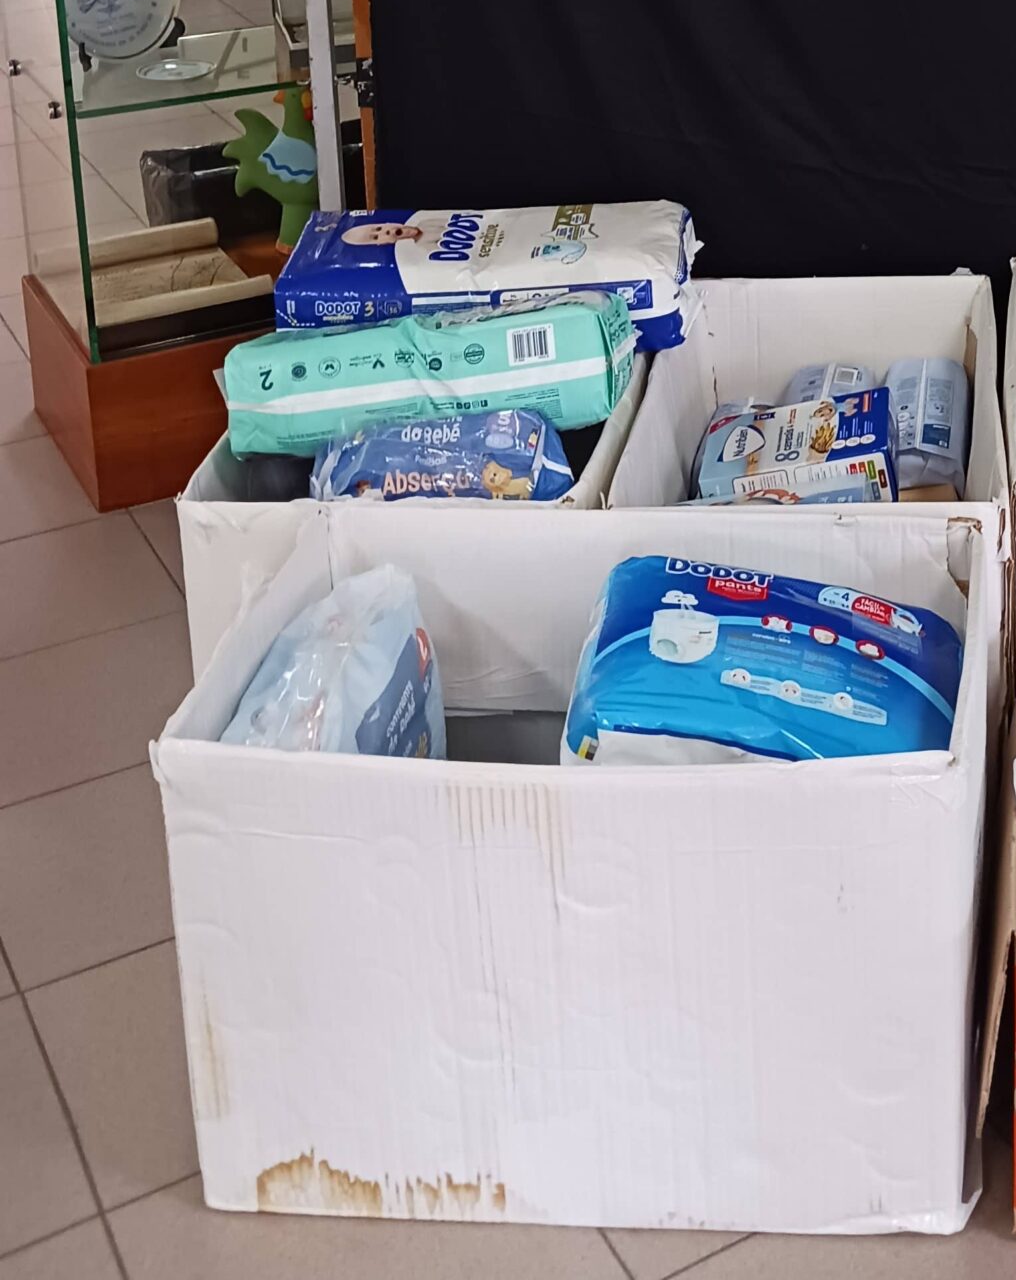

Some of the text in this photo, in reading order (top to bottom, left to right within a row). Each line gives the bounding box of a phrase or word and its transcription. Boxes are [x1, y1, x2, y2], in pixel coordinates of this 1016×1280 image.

[428, 213, 484, 261] DODOT
[315, 300, 361, 316] DODOT
[364, 301, 375, 317] 3
[665, 556, 774, 588] DODOT
[713, 578, 763, 593] pants
[841, 592, 850, 602] 4
